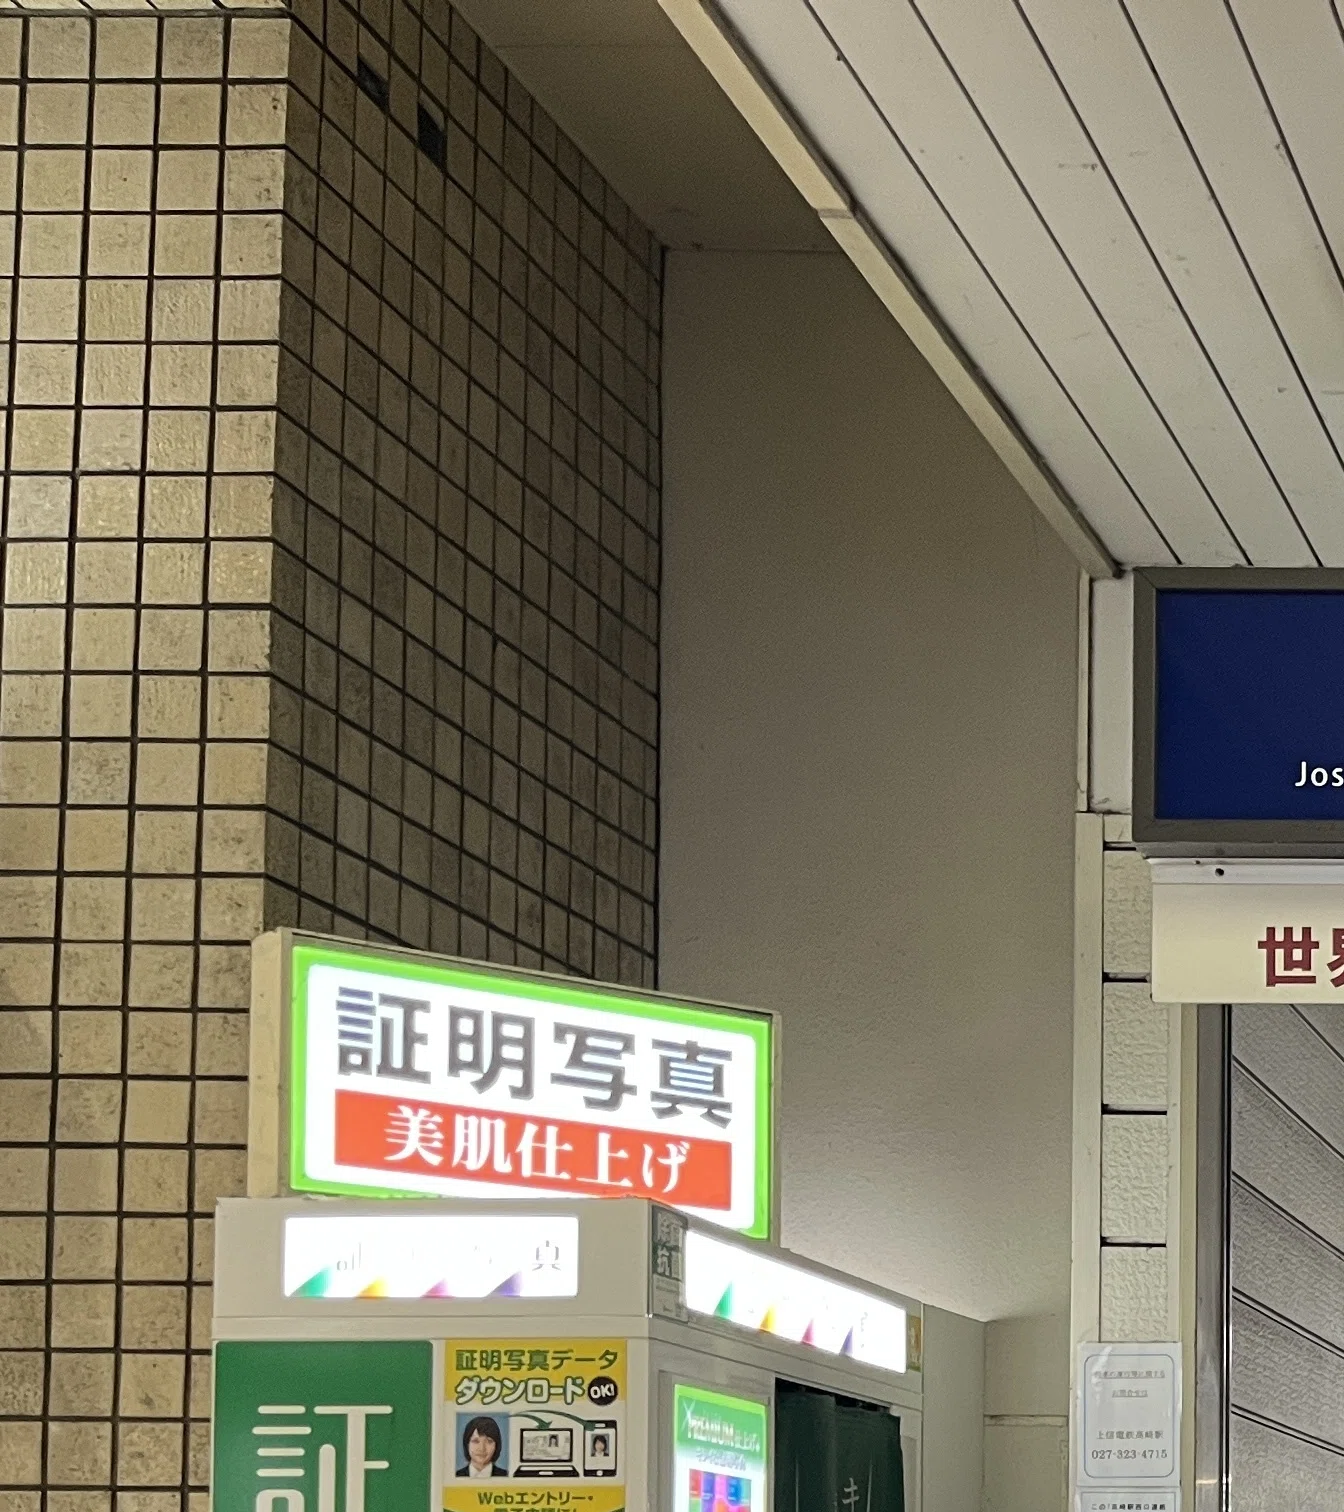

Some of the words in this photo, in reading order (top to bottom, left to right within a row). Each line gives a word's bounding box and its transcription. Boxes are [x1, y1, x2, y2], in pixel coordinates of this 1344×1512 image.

[336, 986, 733, 1130] 証明写真
[383, 1105, 692, 1195] 美肌仕上げ
[455, 1349, 618, 1372] 証明写真データ
[455, 1375, 586, 1406] ダウンロード
[589, 1383, 616, 1399] OK!
